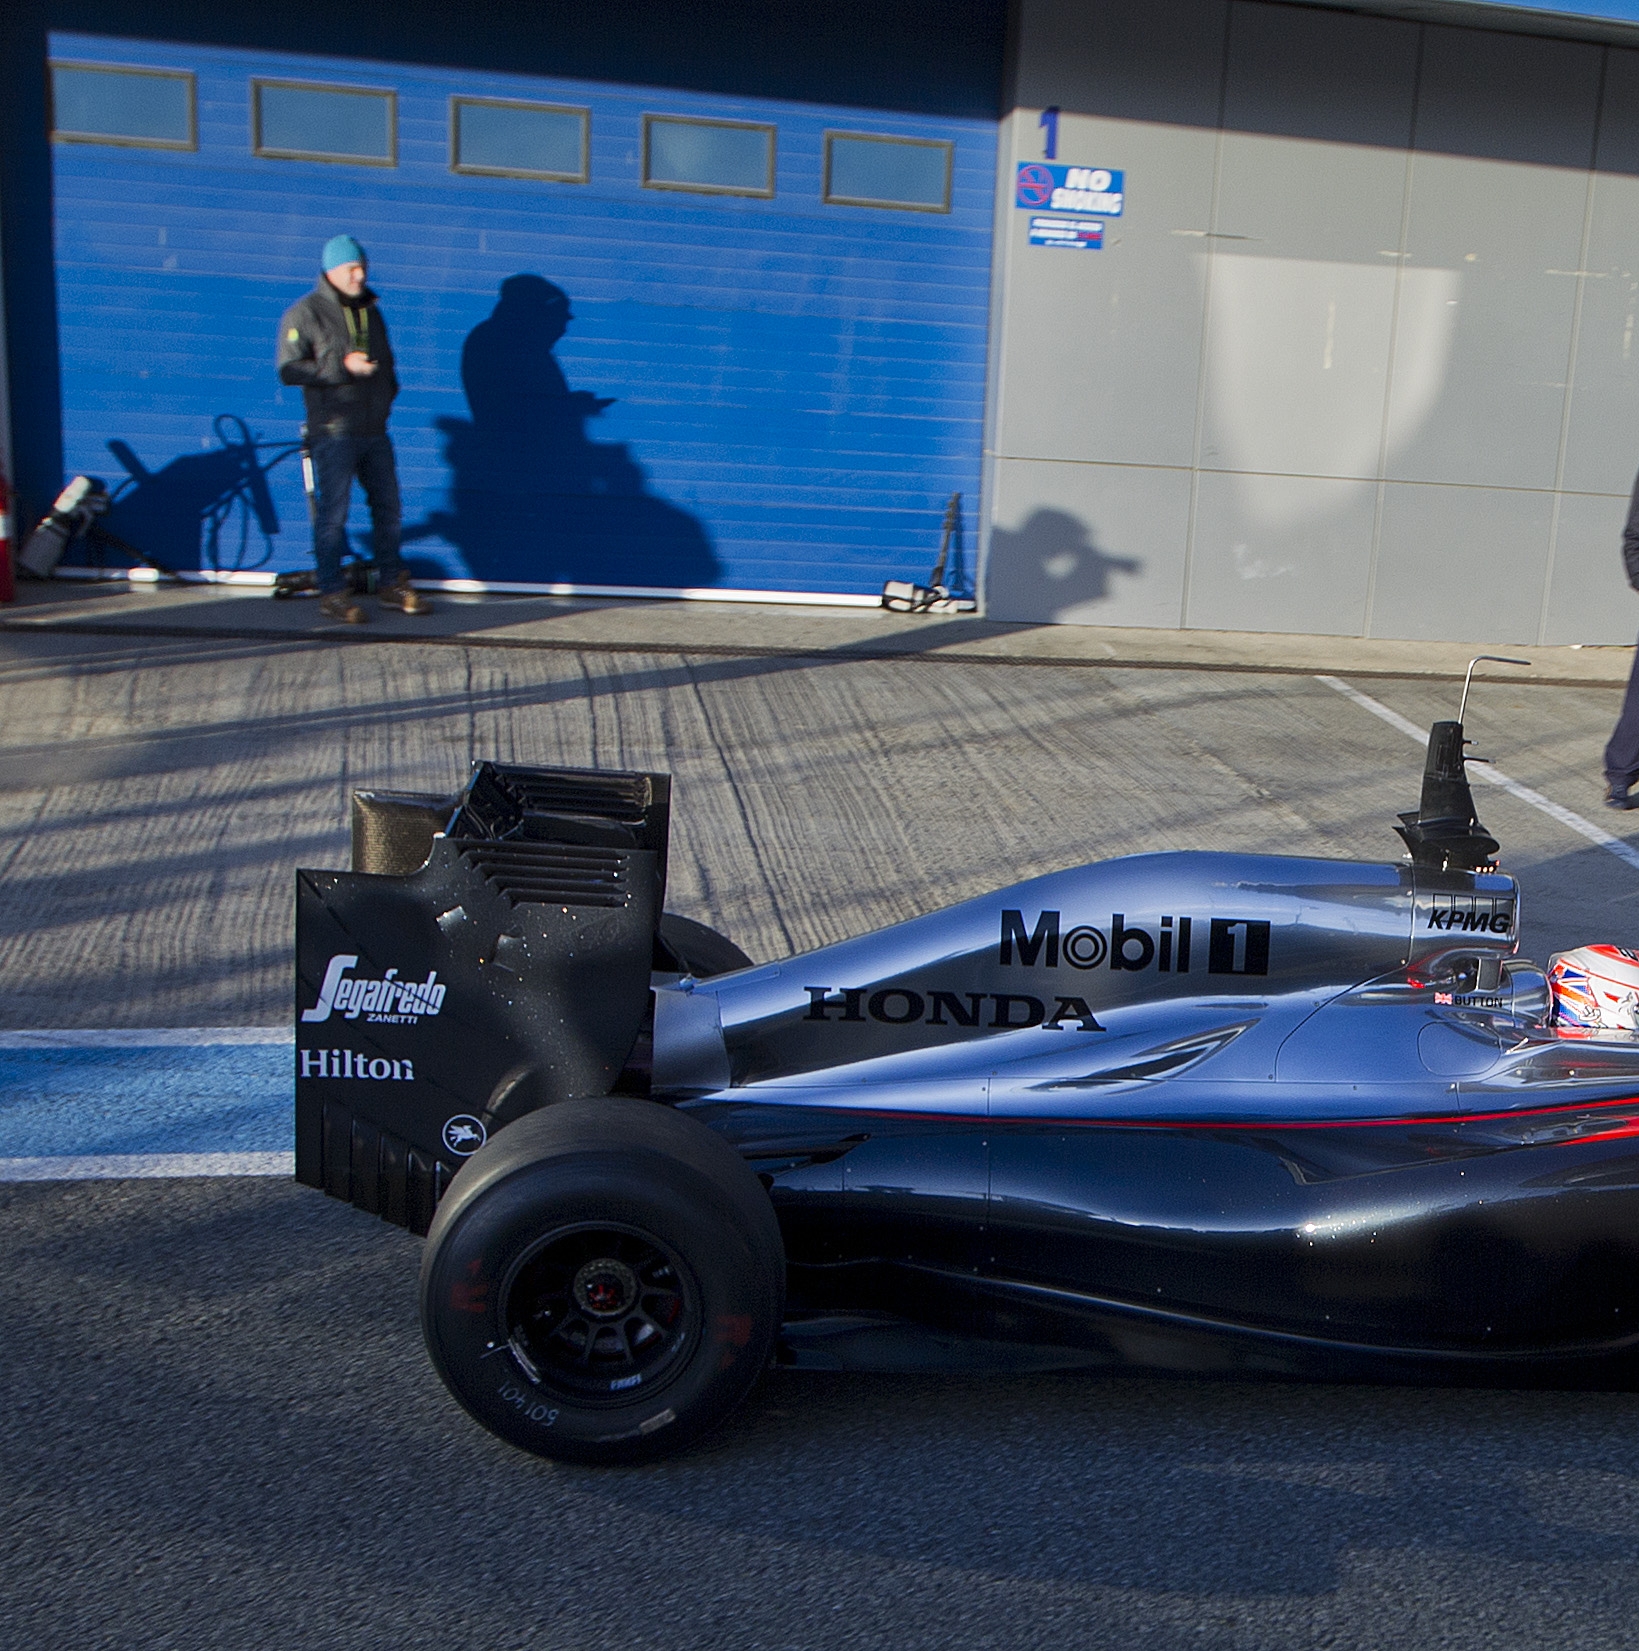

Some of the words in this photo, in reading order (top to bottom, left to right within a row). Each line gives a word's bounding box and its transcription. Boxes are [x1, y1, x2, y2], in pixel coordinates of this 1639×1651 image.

[1039, 106, 1060, 160] 1
[1065, 167, 1112, 191] NO
[1427, 909, 1510, 933] KPMG
[1000, 909, 1191, 973] Mobil
[301, 954, 446, 1022] Segafredo
[1454, 995, 1503, 1007] BUTTON
[366, 1013, 418, 1025] ZANETTI
[803, 986, 1107, 1032] HONDA
[301, 1049, 414, 1080] Hilton
